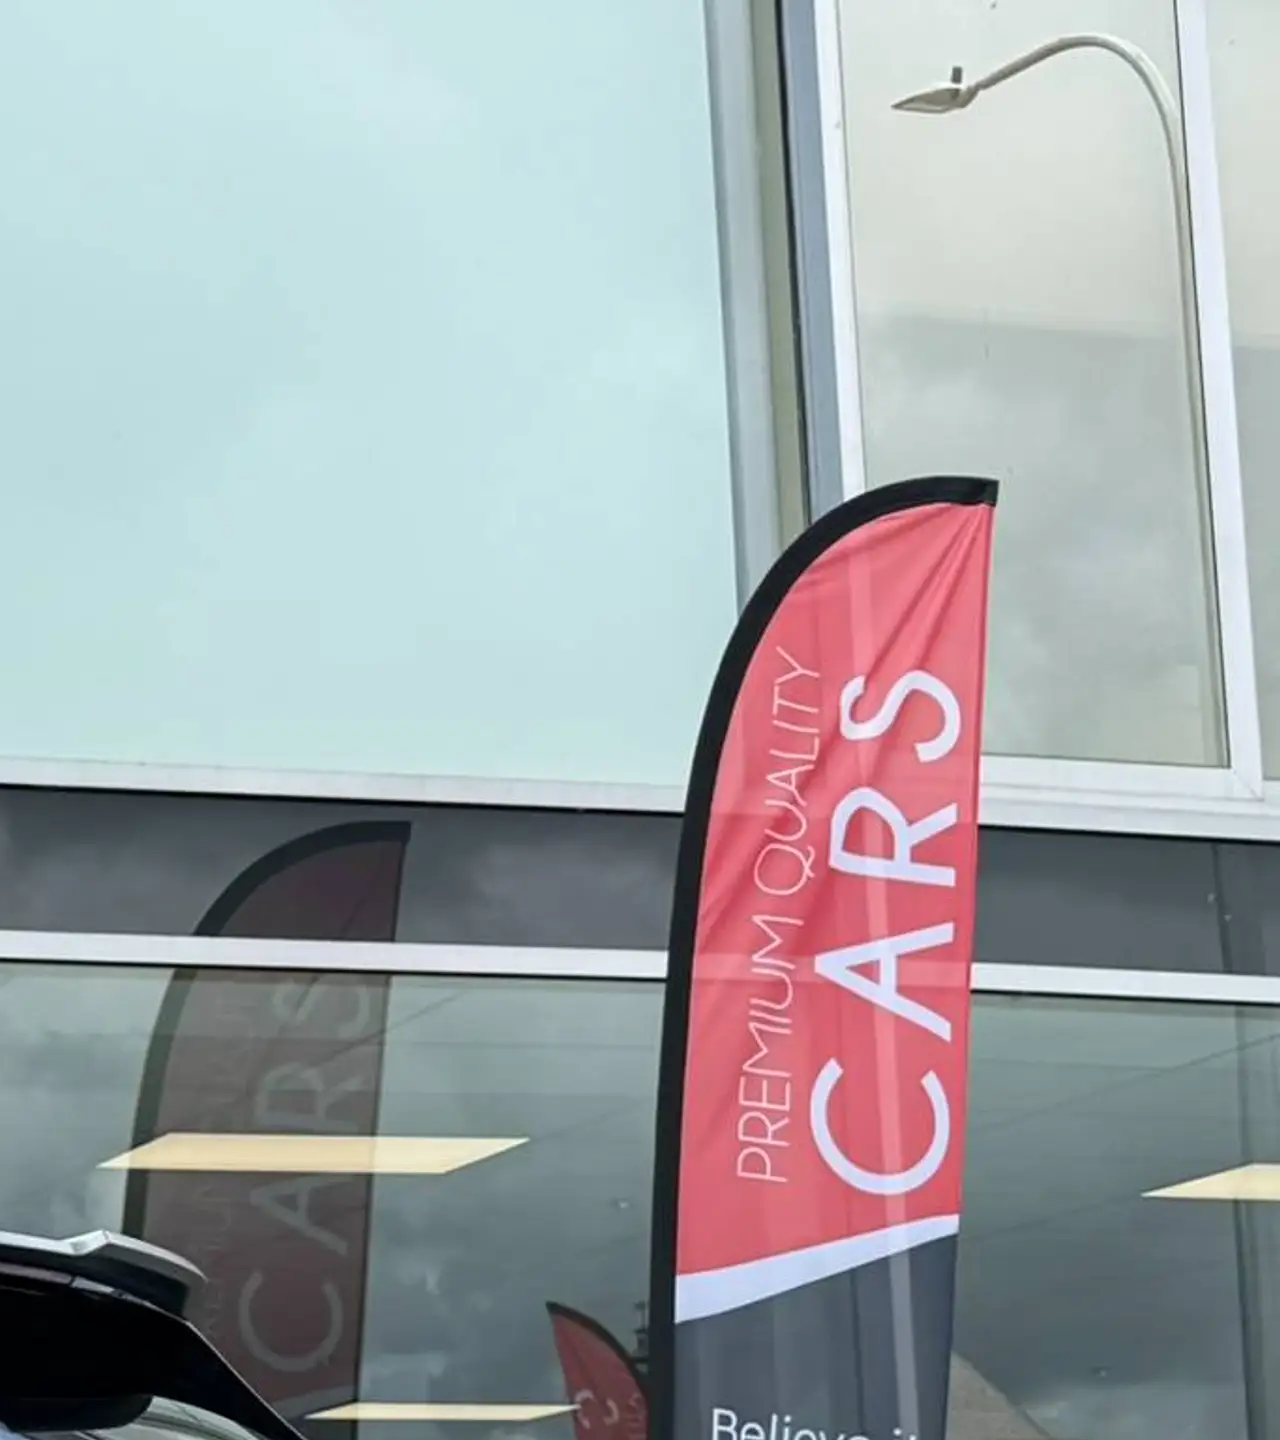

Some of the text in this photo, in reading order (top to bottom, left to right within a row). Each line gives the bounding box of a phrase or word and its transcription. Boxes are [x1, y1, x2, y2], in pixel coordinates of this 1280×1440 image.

[737, 646, 821, 1183] PREMIUM QUALITY
[811, 669, 961, 1195] CARS
